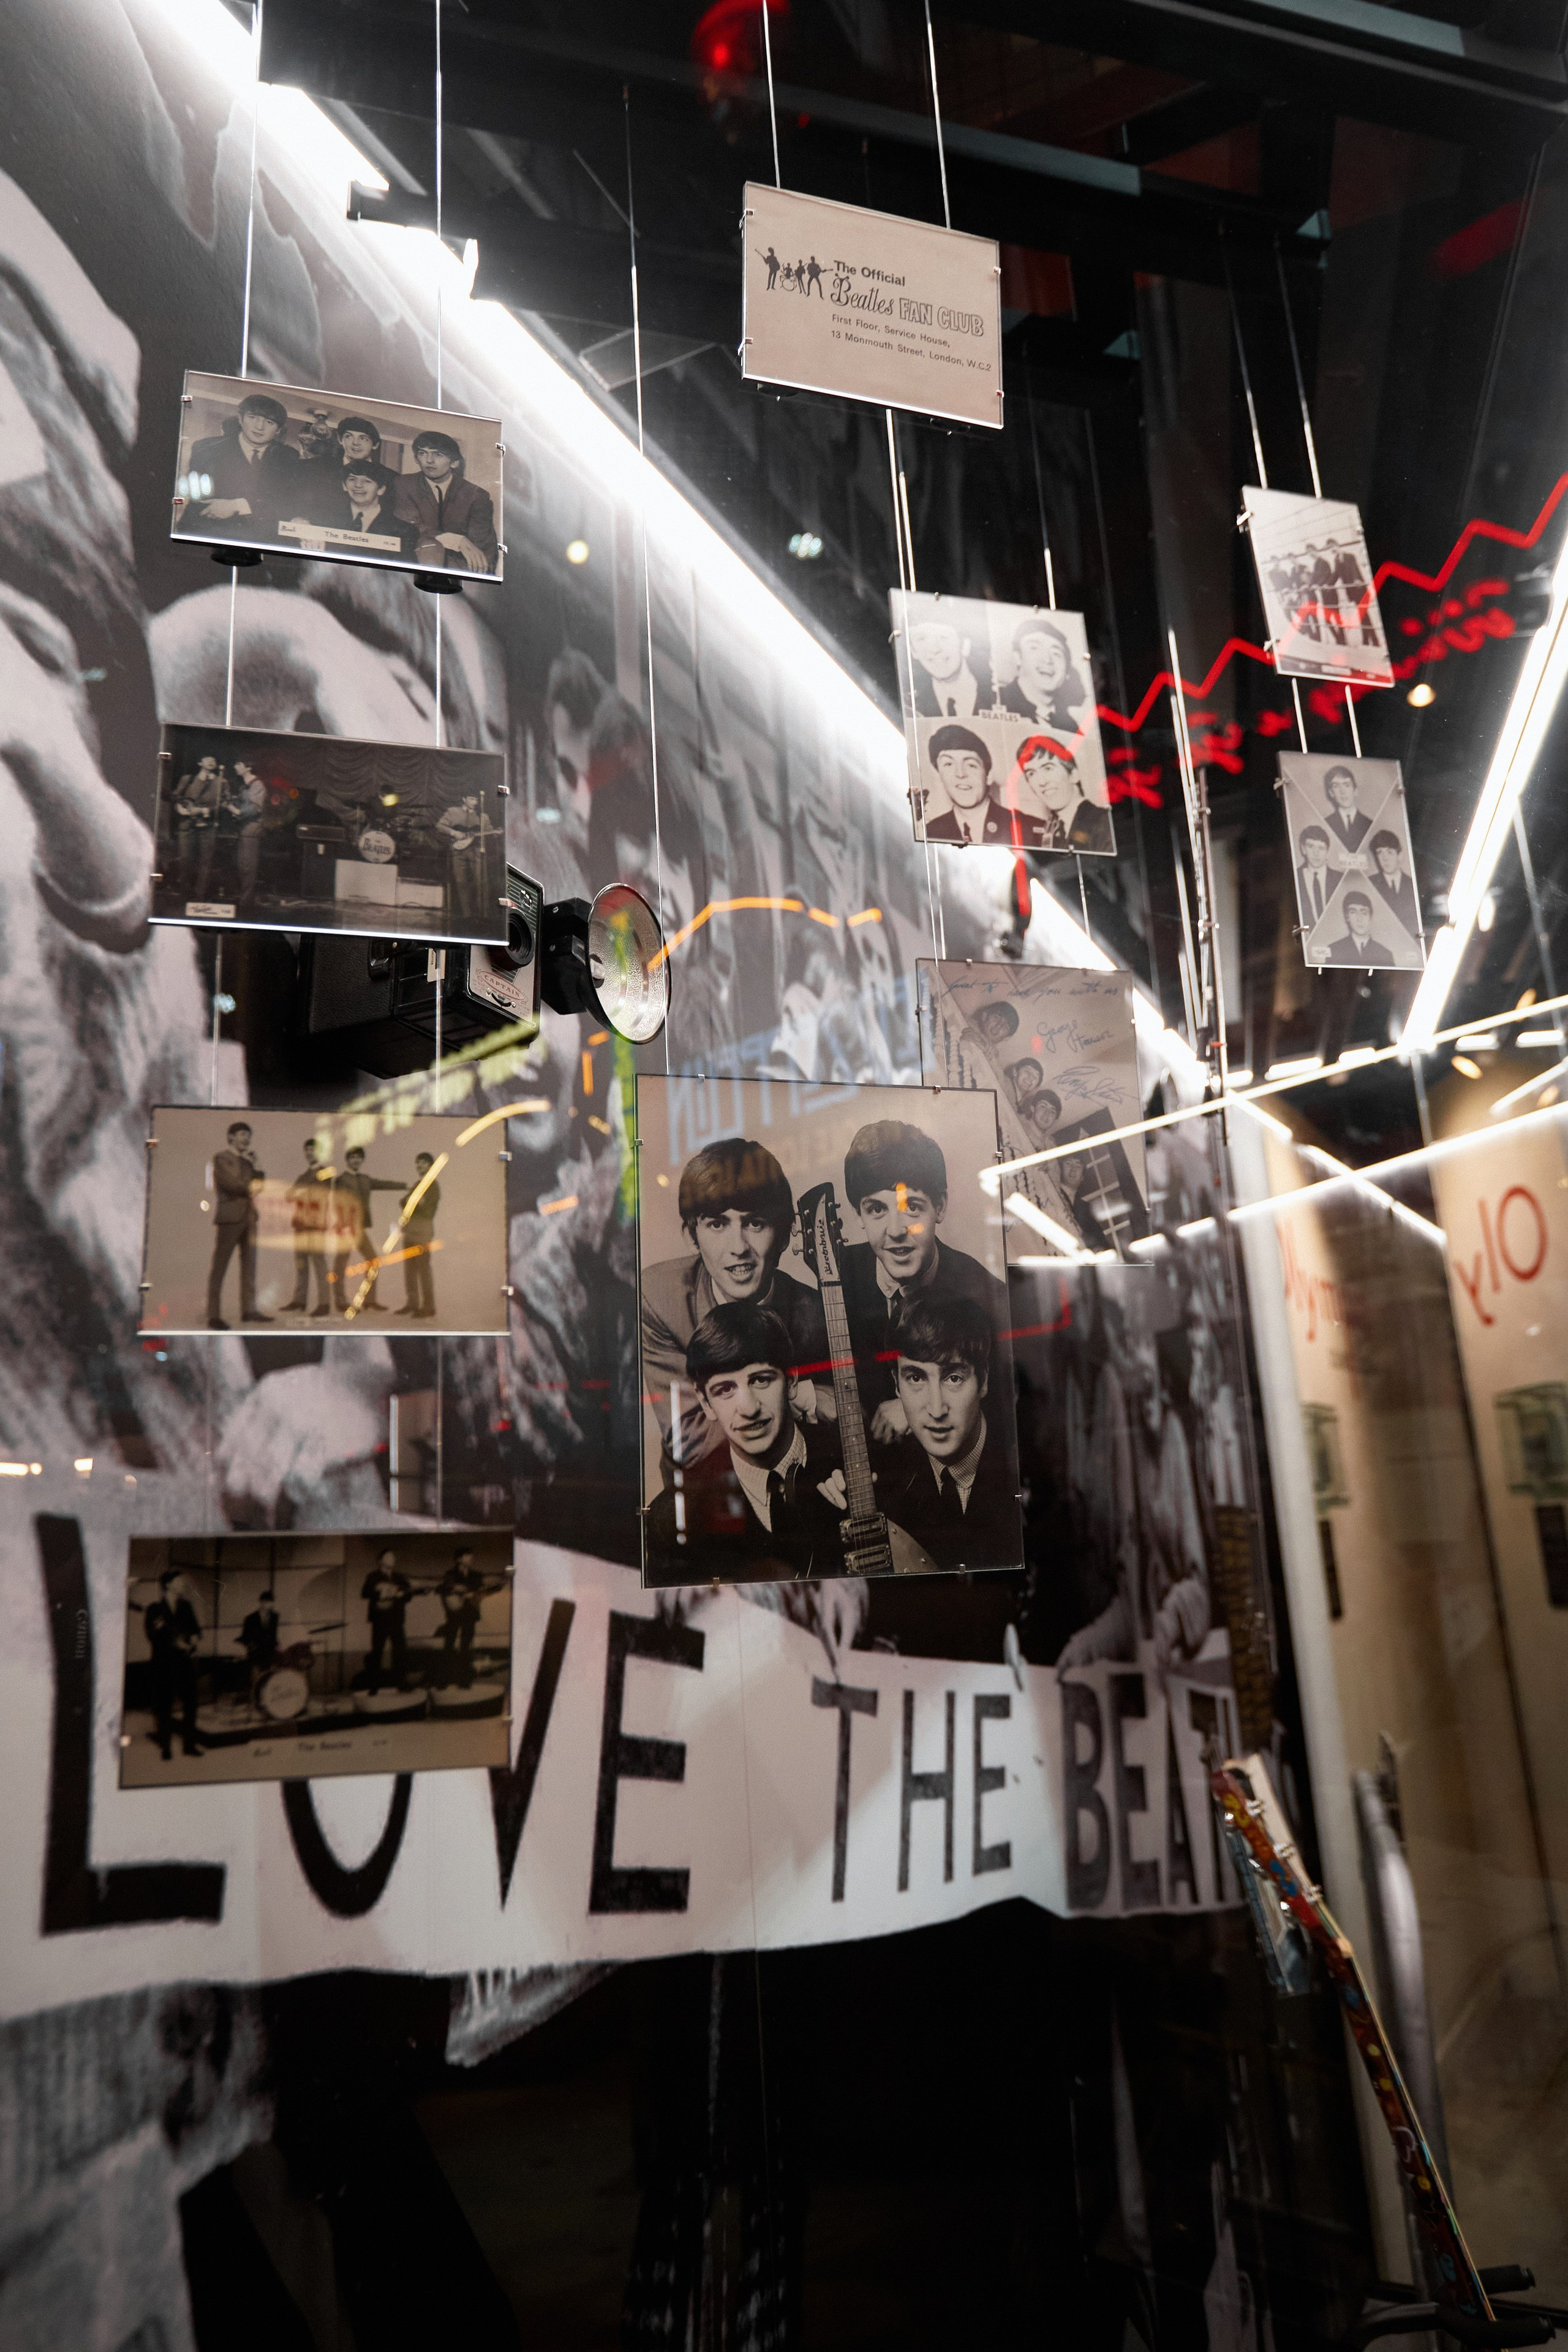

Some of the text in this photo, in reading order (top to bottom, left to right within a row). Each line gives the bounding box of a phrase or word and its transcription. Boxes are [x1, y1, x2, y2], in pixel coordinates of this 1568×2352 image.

[834, 260, 905, 287] The Official
[830, 273, 984, 337] Beatles FAN CLUB
[832, 314, 951, 348] First Floor, Service House,
[831, 330, 841, 339] 13
[845, 333, 893, 350] Monmouth
[897, 344, 925, 358] Street,
[929, 351, 965, 367] London,
[342, 533, 369, 543] Beatles
[484, 974, 521, 997] CAPTAIN
[811, 1675, 1012, 1903] THE
